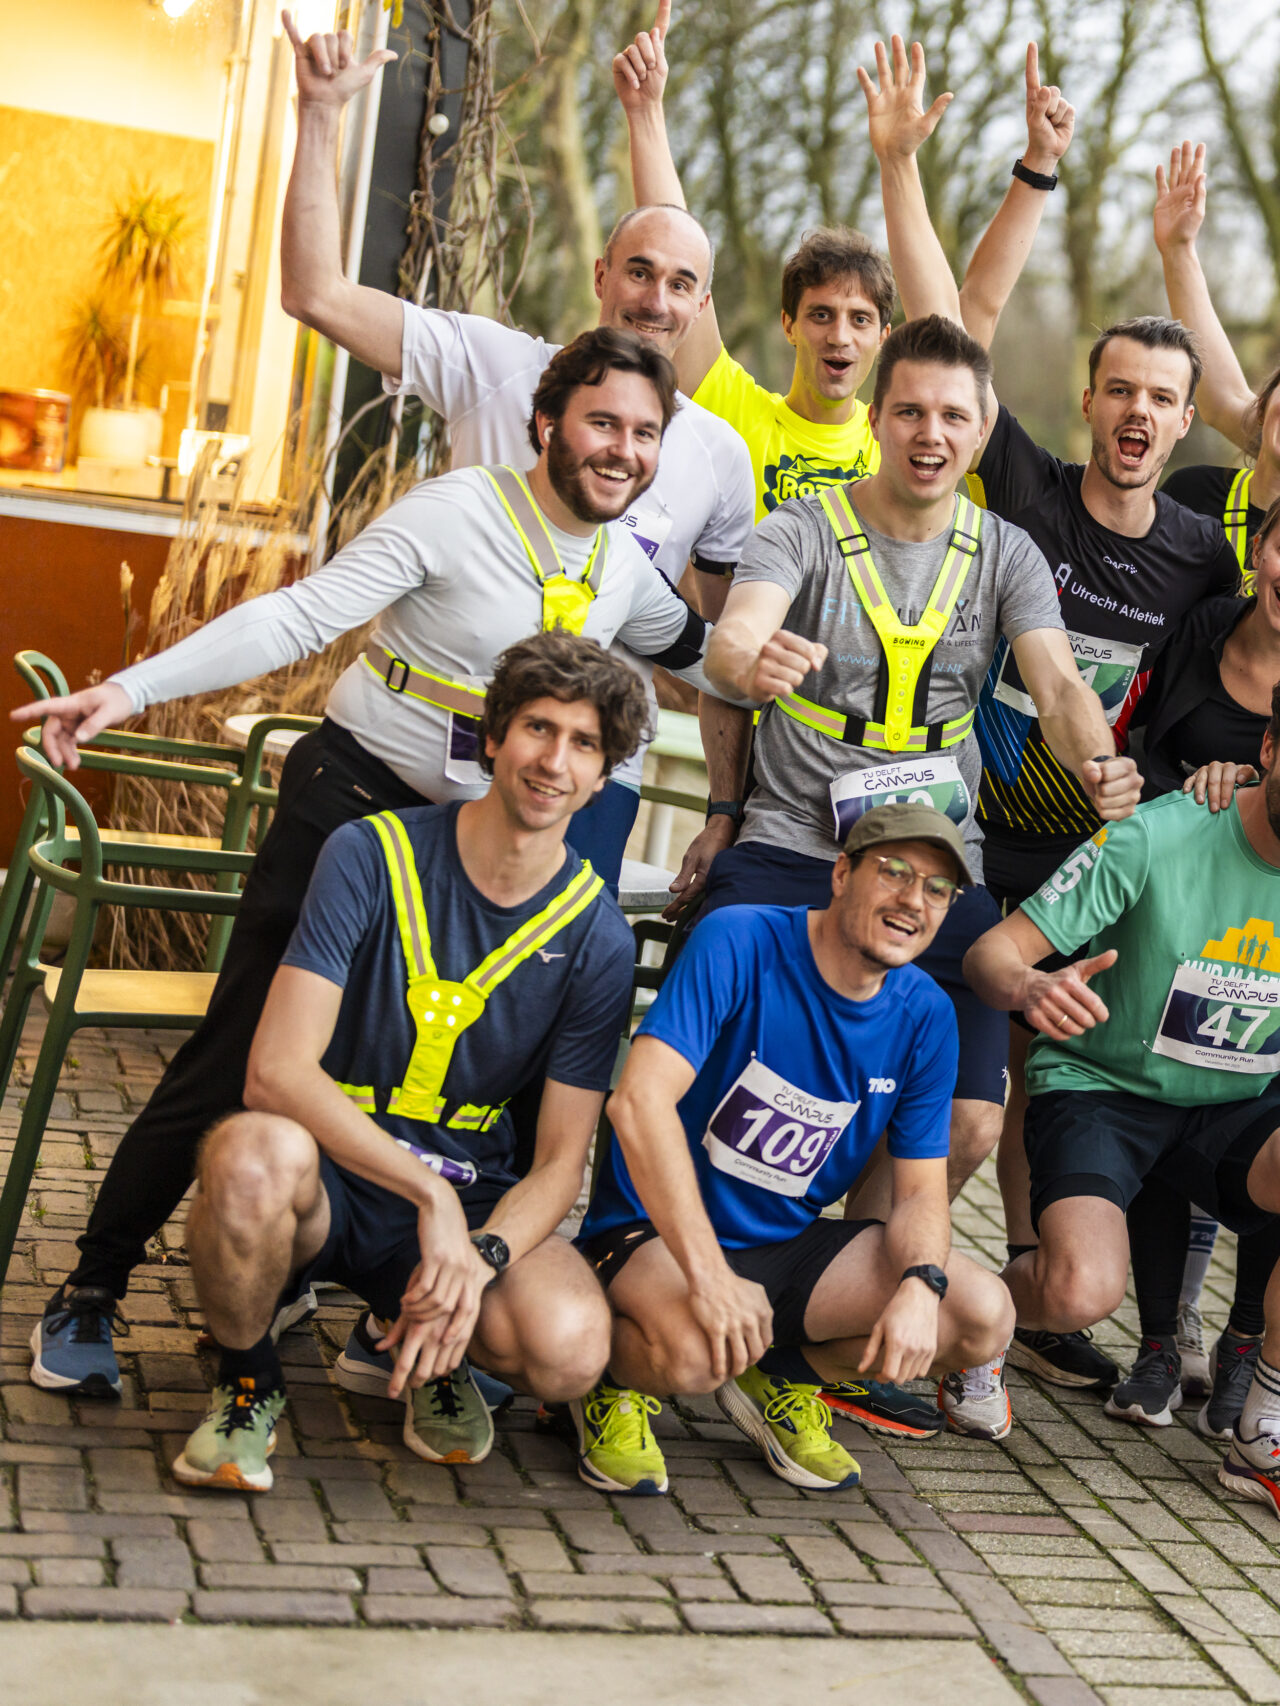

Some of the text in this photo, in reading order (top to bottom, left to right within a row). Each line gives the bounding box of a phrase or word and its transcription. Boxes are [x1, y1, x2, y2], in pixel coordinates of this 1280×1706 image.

[1071, 582, 1165, 626] Utrecht Atletiek
[864, 769, 935, 791] CAMPUS
[875, 766, 901, 777] DELFT
[1211, 978, 1250, 989] TU DELFT
[1207, 985, 1278, 1003] CAMPUS
[1196, 1004, 1271, 1050] 47
[1195, 1049, 1254, 1064] Community Run
[868, 1077, 897, 1094] TNO
[773, 1093, 834, 1124] CAMPUS
[735, 1107, 827, 1174] 109
